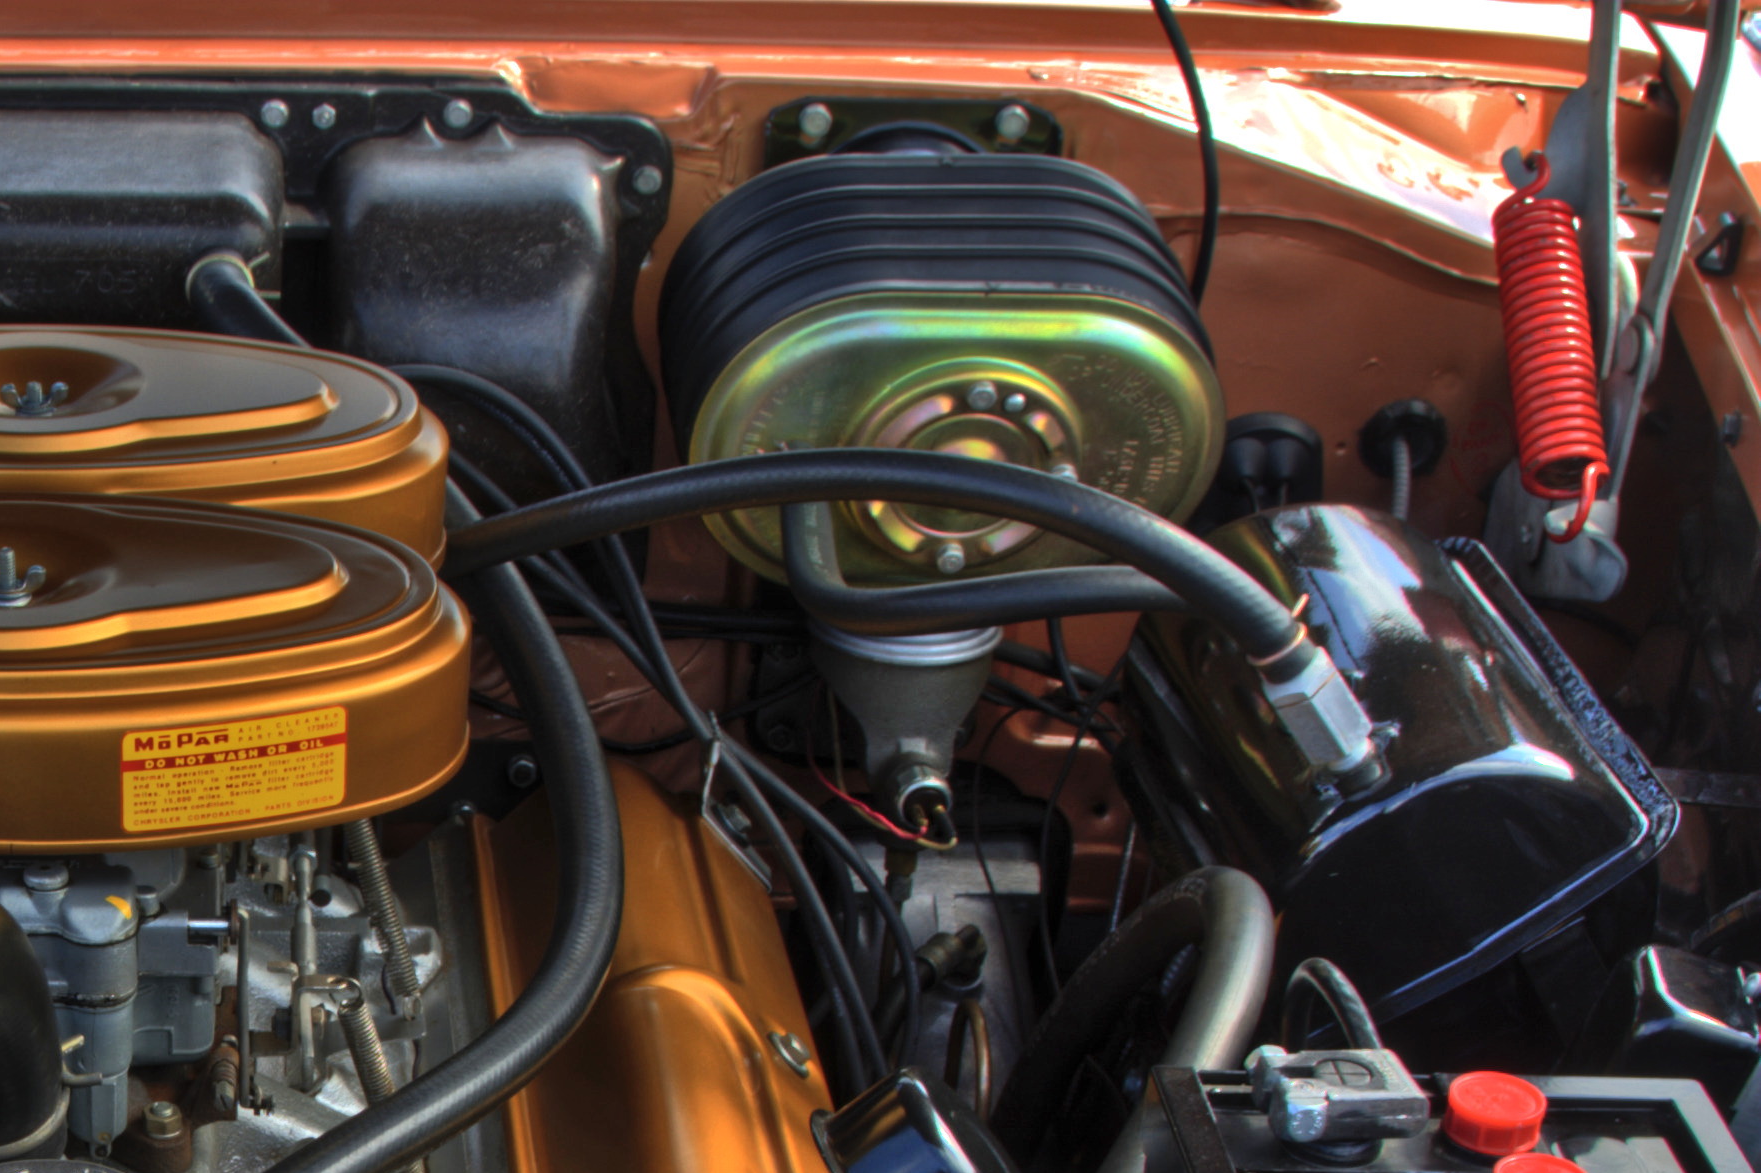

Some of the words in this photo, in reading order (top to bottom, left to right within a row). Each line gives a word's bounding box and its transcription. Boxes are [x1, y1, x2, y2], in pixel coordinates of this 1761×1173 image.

[239, 724, 261, 733] AIR
[276, 713, 339, 729] CLEANER
[238, 732, 271, 742] PART
[144, 758, 166, 769] DO
[175, 755, 206, 766] NOT
[213, 748, 258, 762] WASH
[267, 744, 287, 755] OR
[299, 739, 323, 750] OIL
[133, 773, 165, 781] Normal
[172, 769, 215, 779] operation
[229, 763, 263, 771] Remove
[268, 759, 290, 767] filter
[295, 751, 334, 763] cartridge
[176, 779, 204, 788] gently
[225, 772, 257, 780] remove
[283, 765, 306, 773] every
[295, 768, 334, 778] cartridge
[229, 788, 261, 797] Service
[266, 784, 287, 792] more
[292, 777, 334, 788] frequently
[133, 816, 181, 826] CHRYSLER
[187, 808, 251, 821] CORPORATION
[264, 801, 291, 811] PARTS
[296, 795, 334, 806] DIVISION
